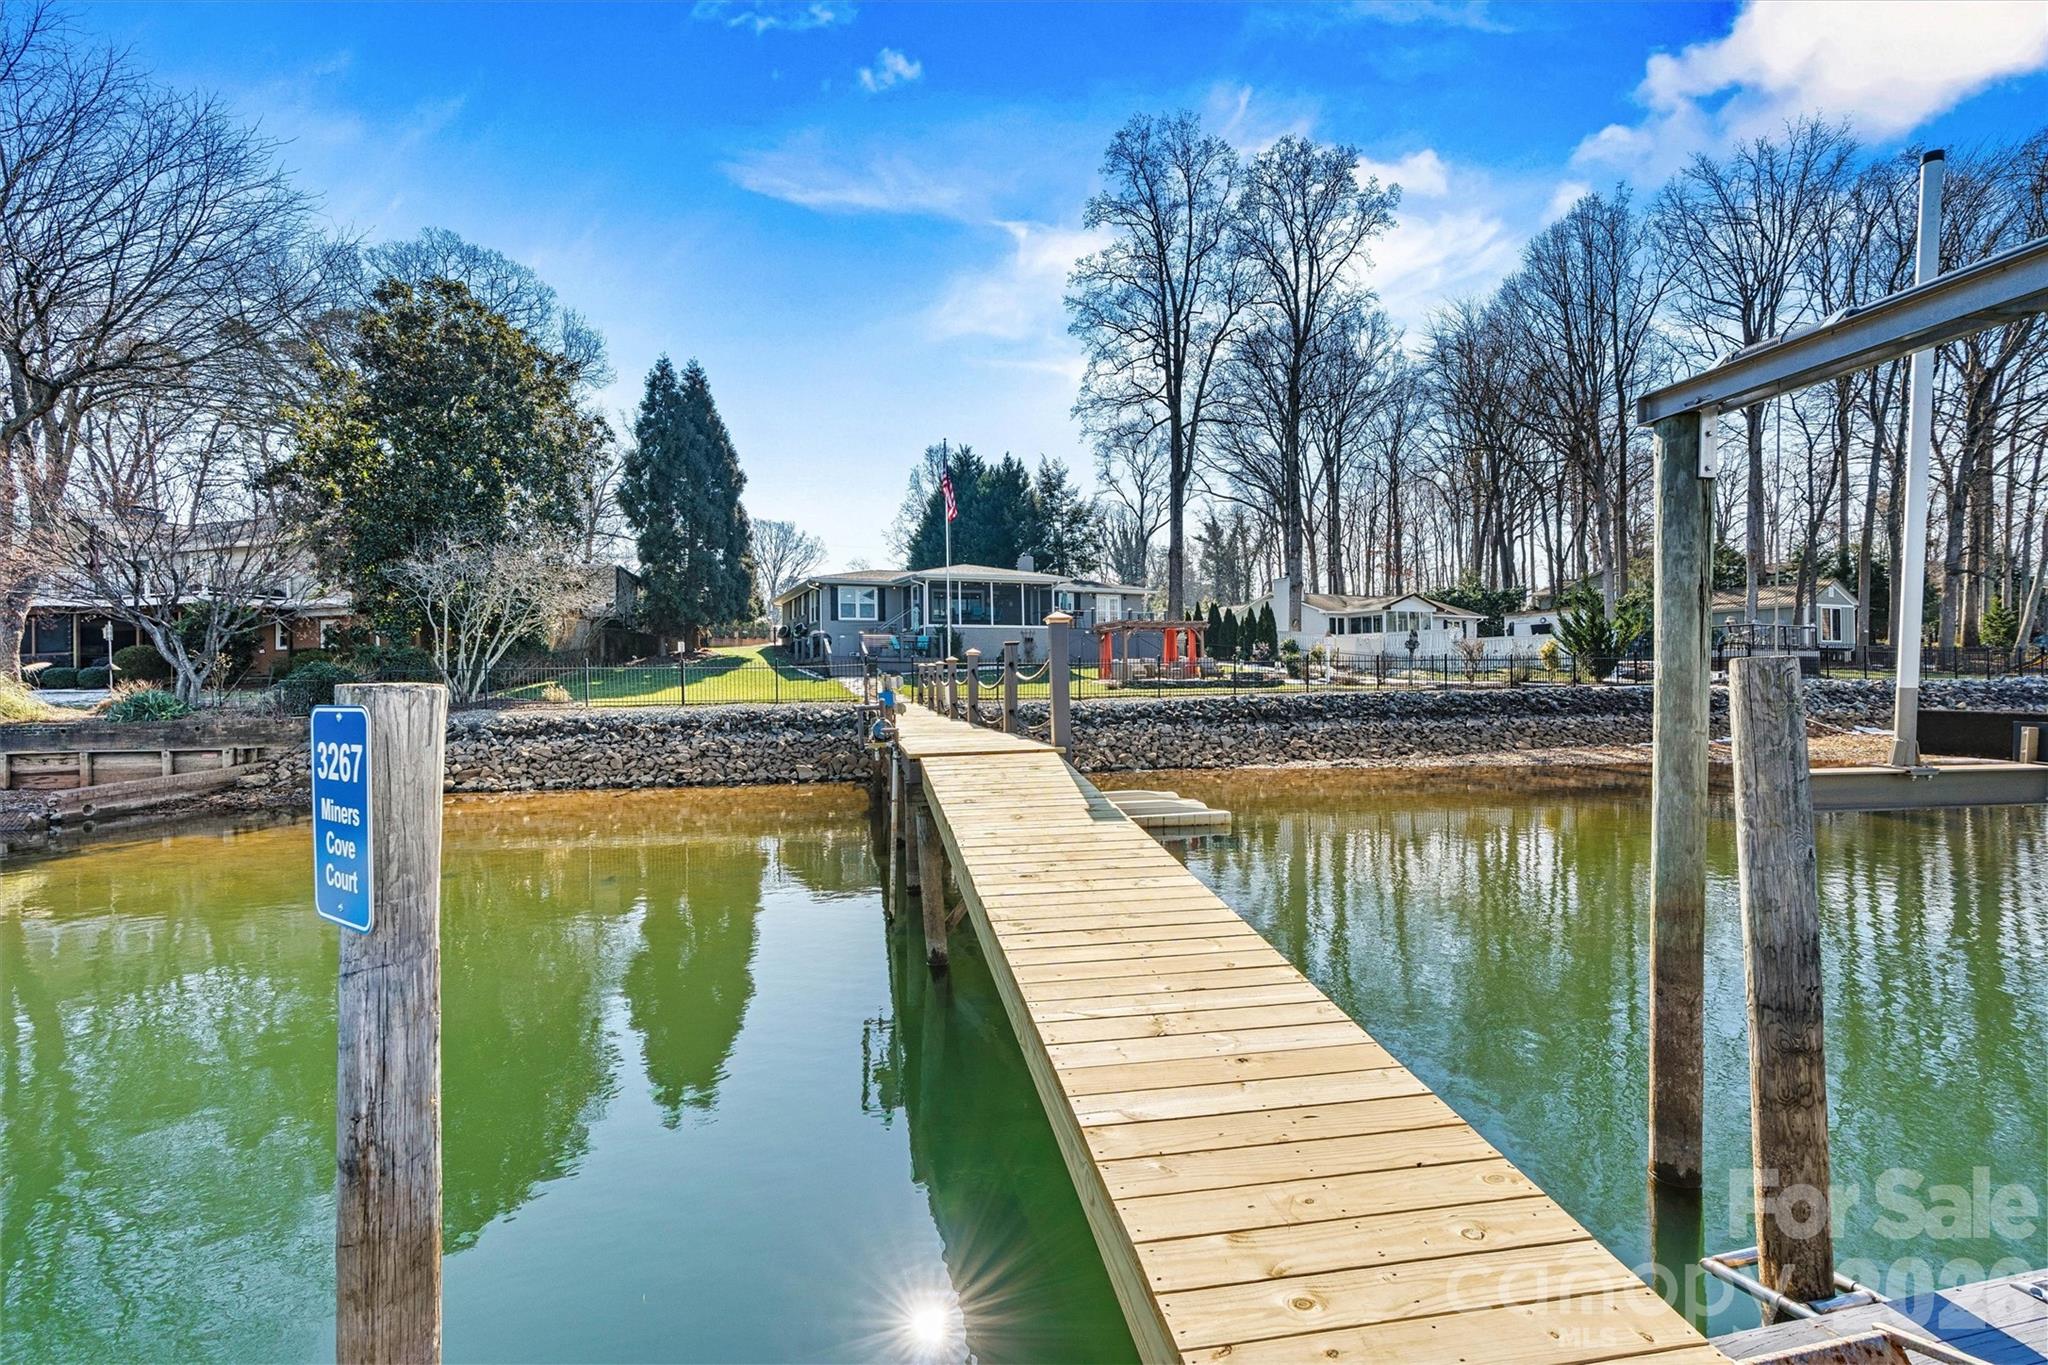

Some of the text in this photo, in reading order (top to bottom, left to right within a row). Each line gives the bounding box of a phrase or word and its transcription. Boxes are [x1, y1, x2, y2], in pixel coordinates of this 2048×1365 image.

[317, 741, 362, 783] 3267
[321, 797, 360, 827] Miners
[325, 831, 356, 860] Cove
[325, 863, 358, 894] Court
